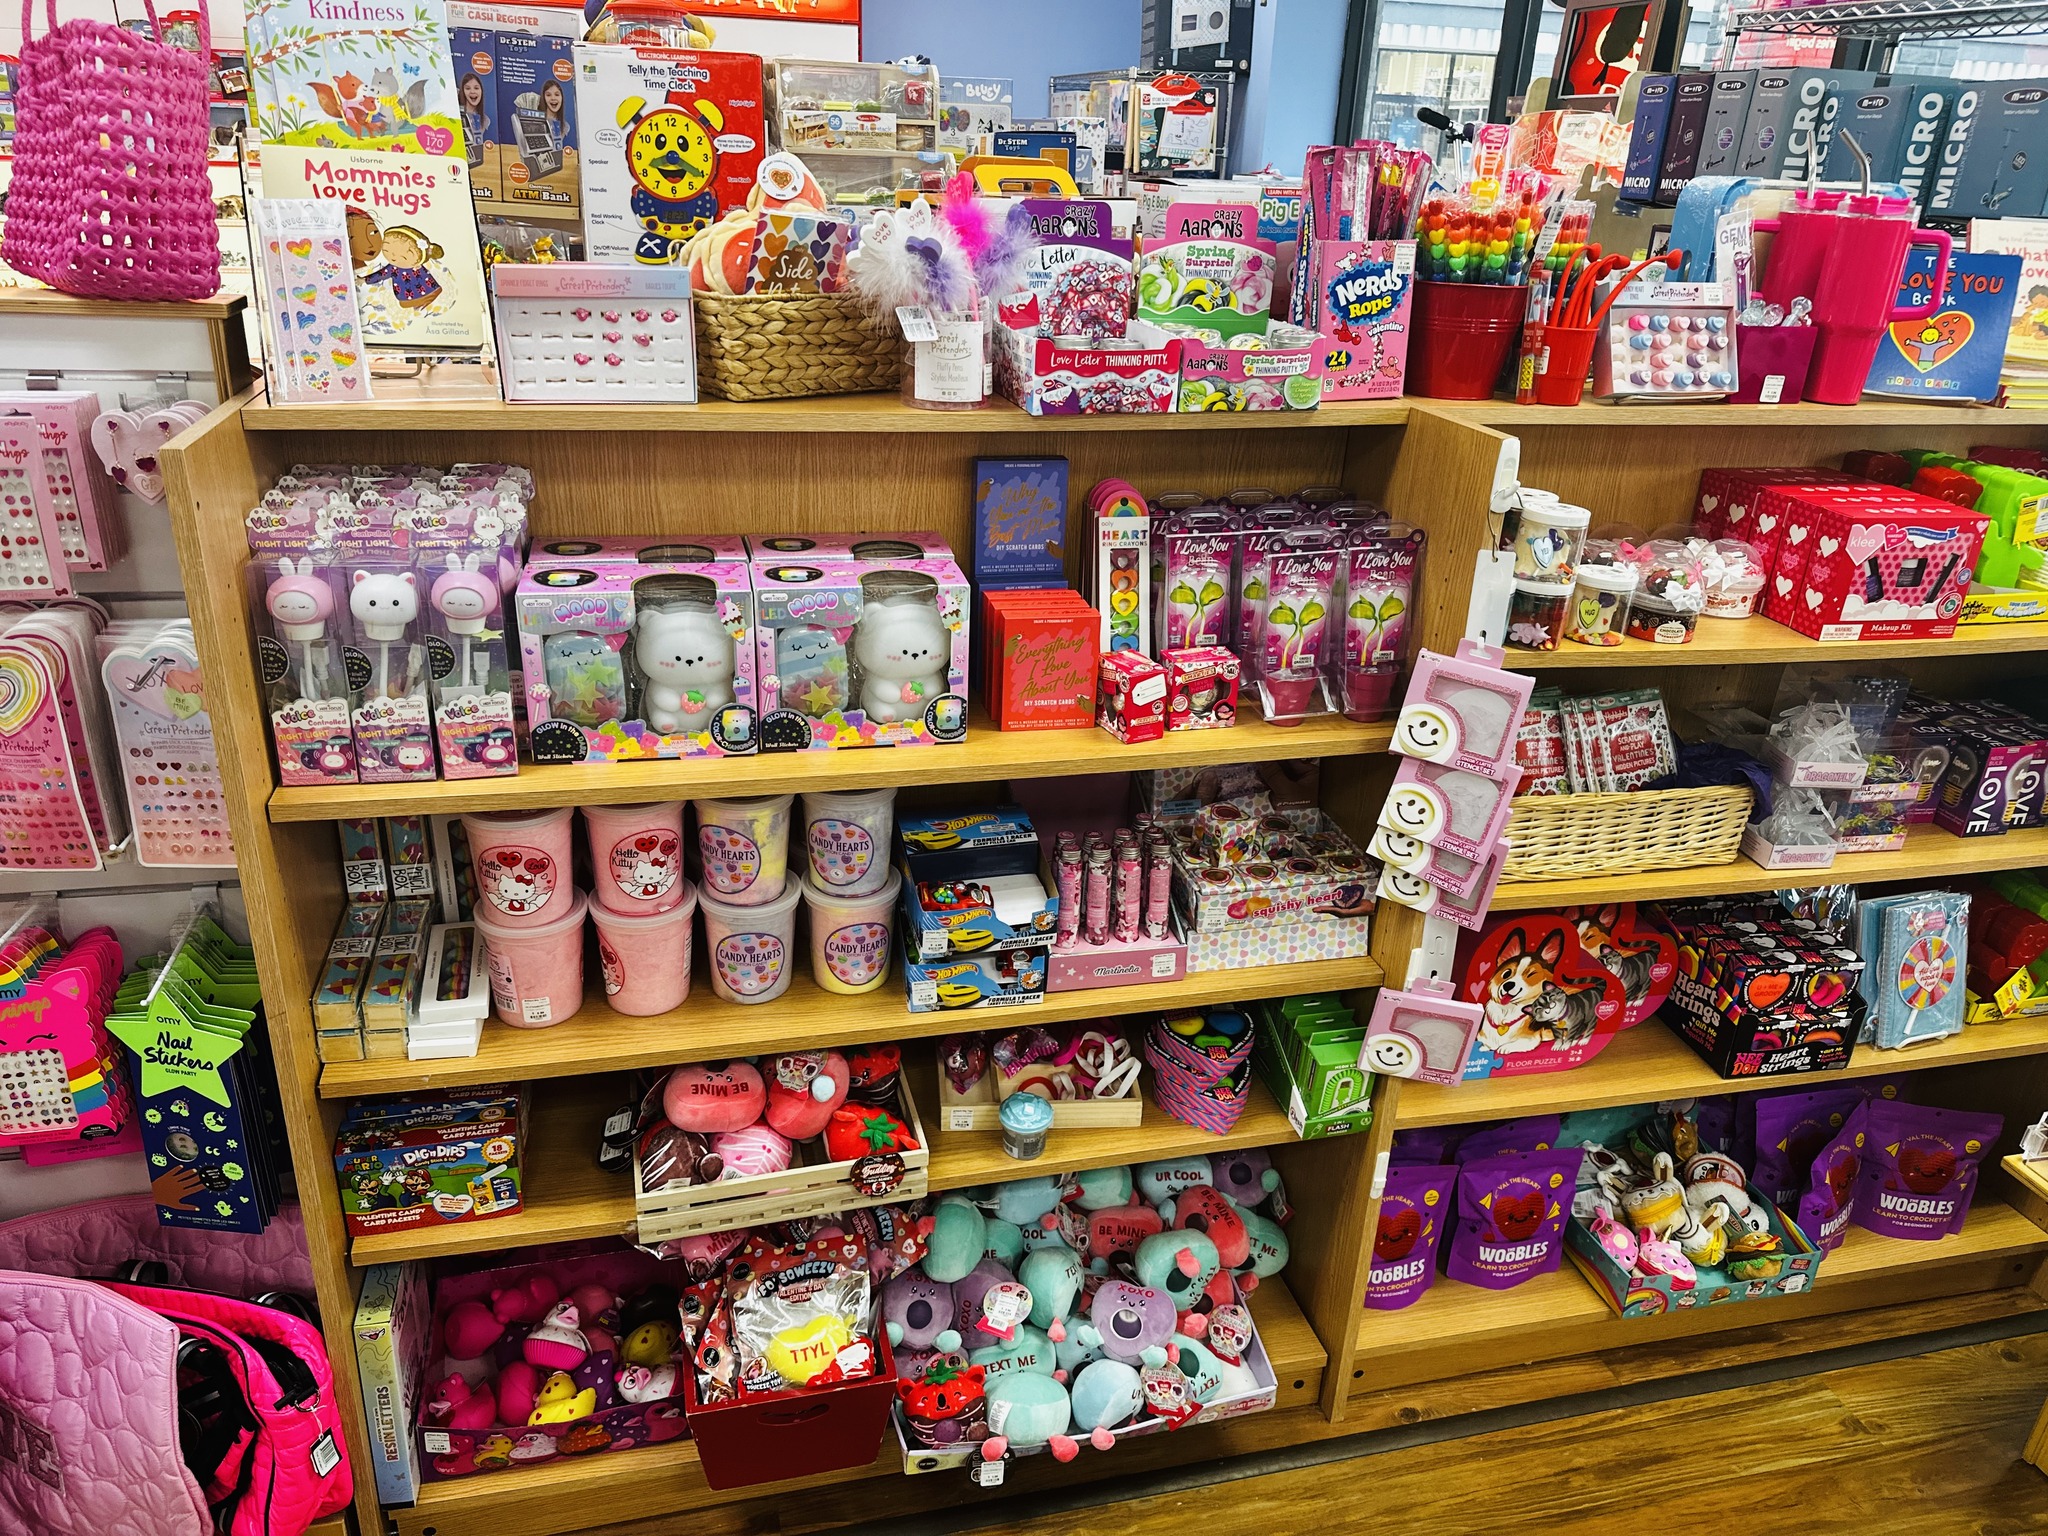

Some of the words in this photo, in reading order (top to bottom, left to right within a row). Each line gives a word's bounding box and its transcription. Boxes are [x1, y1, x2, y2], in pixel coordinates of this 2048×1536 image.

[308, 0, 405, 22] Kindness
[467, 10, 494, 22] CASH
[496, 12, 540, 27] REGISTER
[508, 44, 529, 53] Toys
[638, 52, 669, 60] ELECTRONIC
[669, 54, 698, 62] LEARNING
[627, 64, 648, 77] Telly
[649, 66, 665, 76] the
[667, 66, 708, 80] Teaching
[643, 79, 666, 90] Time
[668, 80, 694, 91] Clock
[426, 137, 444, 148] 170
[350, 156, 384, 165] Usborne
[588, 158, 609, 166] Speaker
[304, 158, 437, 190] Mommies
[1624, 177, 1651, 189] MICRO
[1660, 178, 1689, 190] MICRO
[312, 183, 367, 203] love
[371, 187, 432, 216] Hugs
[512, 188, 541, 200] ATM
[541, 190, 571, 202] Bank
[603, 213, 623, 221] Working
[1261, 200, 1288, 222] Pig
[877, 230, 892, 245] YOU
[1719, 230, 1747, 246] GEM
[1040, 247, 1079, 271] Letter
[1186, 244, 1236, 261] Spring
[774, 255, 813, 281] Side
[1186, 257, 1234, 269] Surprise!
[1185, 268, 1212, 279] THINKING
[1028, 280, 1048, 289] PUTTY
[1653, 286, 1670, 299] Great
[1669, 287, 1697, 299] Pretenders
[1348, 295, 1393, 319] Rope
[1366, 321, 1405, 338] valentine
[1050, 352, 1073, 368] Love
[1074, 352, 1103, 368] Letter
[1104, 354, 1142, 367] THINKING
[1242, 355, 1275, 366] Spring
[1276, 353, 1311, 364] Surprise!
[1924, 378, 1961, 391] PARR
[250, 515, 288, 530] Voice
[269, 529, 309, 539] Controlled
[1101, 529, 1148, 540] HEART
[1849, 533, 1876, 549] klee
[255, 539, 282, 549] NIGHT
[283, 538, 309, 548] LIGHT
[1181, 540, 1207, 555] Love
[1207, 538, 1230, 552] You
[788, 592, 838, 618] MOOD
[1584, 608, 1596, 617] HUG
[1871, 622, 1900, 633] Makeup
[1900, 622, 1912, 631] Kit
[1014, 635, 1087, 665] Everything
[1041, 658, 1071, 679] Love
[172, 702, 191, 713] MINE
[1036, 699, 1057, 707] SCRATCH
[1057, 698, 1075, 706] CARDS
[1604, 709, 1628, 722] Highlights
[1612, 749, 1656, 763] VALENTINE'S
[1456, 759, 1482, 774] STENCIL
[1481, 766, 1496, 776] SET
[1615, 763, 1633, 771] HIDDEN
[1633, 757, 1656, 769] PICTURES
[1803, 771, 1855, 783] DRAGONFLY
[1965, 765, 2007, 835] LOVE
[947, 817, 965, 832] HOT
[965, 814, 998, 827] WHEELS
[811, 834, 835, 851] CANDY
[836, 840, 870, 852] HEARTS
[1840, 836, 1859, 845] SMILE
[1848, 841, 1881, 850] everyday
[611, 857, 636, 869] Kitty
[1778, 852, 1826, 863] DRAGONFLY
[481, 858, 502, 872] Hello
[1252, 899, 1303, 919] squishy
[1306, 889, 1344, 907] heart
[156, 1015, 182, 1026] omy
[156, 1030, 194, 1052] Nail
[144, 1047, 215, 1072] Stickers
[1736, 1052, 1766, 1066] NEE
[1769, 1046, 1810, 1063] Heart
[1506, 1058, 1530, 1068] FLOOR
[1530, 1056, 1563, 1067] PUZZLE
[1759, 1055, 1812, 1075] Strings
[179, 1068, 198, 1078] PARTY
[1731, 1064, 1761, 1076] DOH
[1327, 1122, 1351, 1132] FLASH
[346, 1154, 379, 1165] SUPER
[343, 1161, 384, 1173] MARIO
[1155, 1171, 1172, 1182] UR
[1173, 1169, 1205, 1182] COOL
[1497, 1182, 1510, 1192] VAL
[1509, 1176, 1521, 1185] THE
[1521, 1176, 1542, 1191] HEART
[356, 1211, 398, 1222] VALENTINE
[397, 1207, 427, 1218] CANDY
[363, 1218, 388, 1228] CARD
[387, 1214, 421, 1224] PACKETS
[1872, 1206, 1898, 1220] LEARN
[1909, 1215, 1943, 1223] CROCHET
[1098, 1226, 1114, 1237] BE
[1116, 1224, 1148, 1239] MINE
[1117, 1282, 1155, 1298] XOXO
[1376, 1284, 1386, 1292] TO
[1386, 1278, 1417, 1291] CROCHET
[789, 1292, 813, 1303] EDITION
[789, 1341, 830, 1364] TTYL
[983, 1358, 1013, 1376] TEXT
[1017, 1354, 1038, 1367] ME
[376, 1385, 397, 1429] LETTERS
[385, 1428, 399, 1462] RESIN
